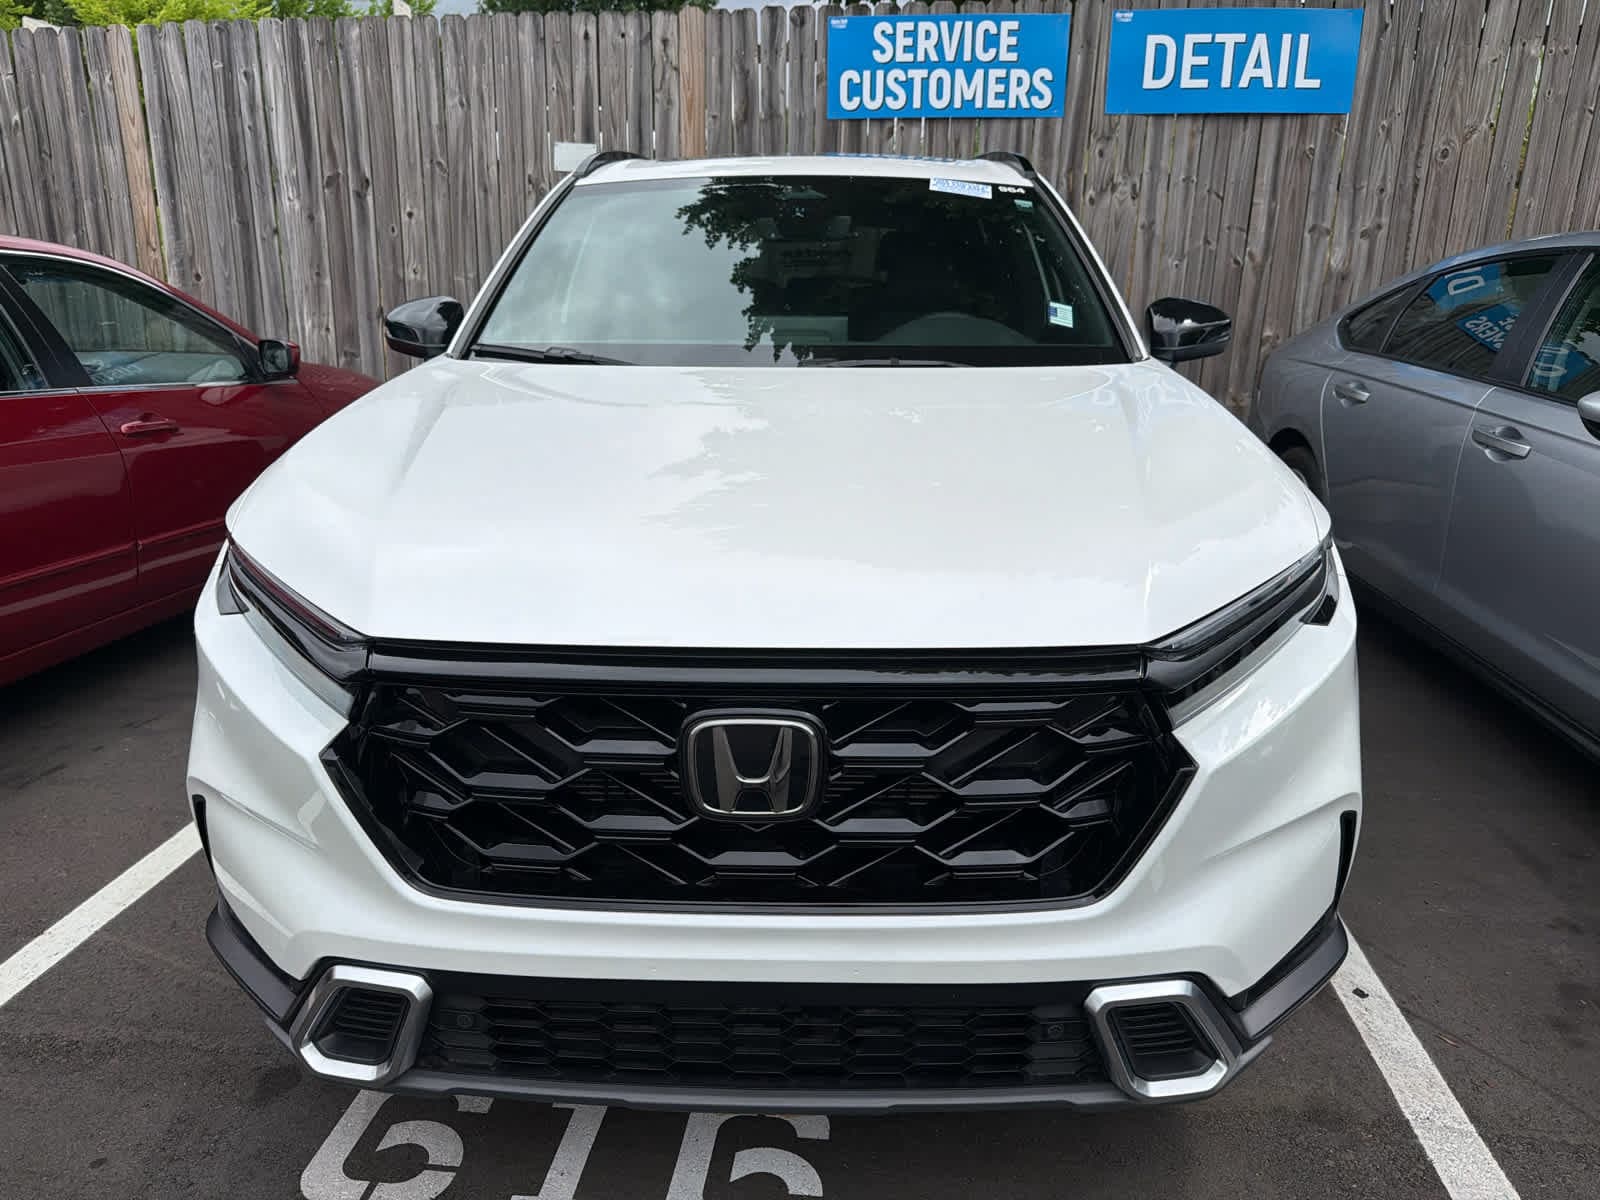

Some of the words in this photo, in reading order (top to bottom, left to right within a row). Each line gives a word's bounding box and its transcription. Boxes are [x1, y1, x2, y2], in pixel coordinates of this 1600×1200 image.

[872, 20, 1020, 63] SERVICE
[1141, 32, 1321, 90] DETAIL
[839, 68, 1053, 111] CUSTOMERS
